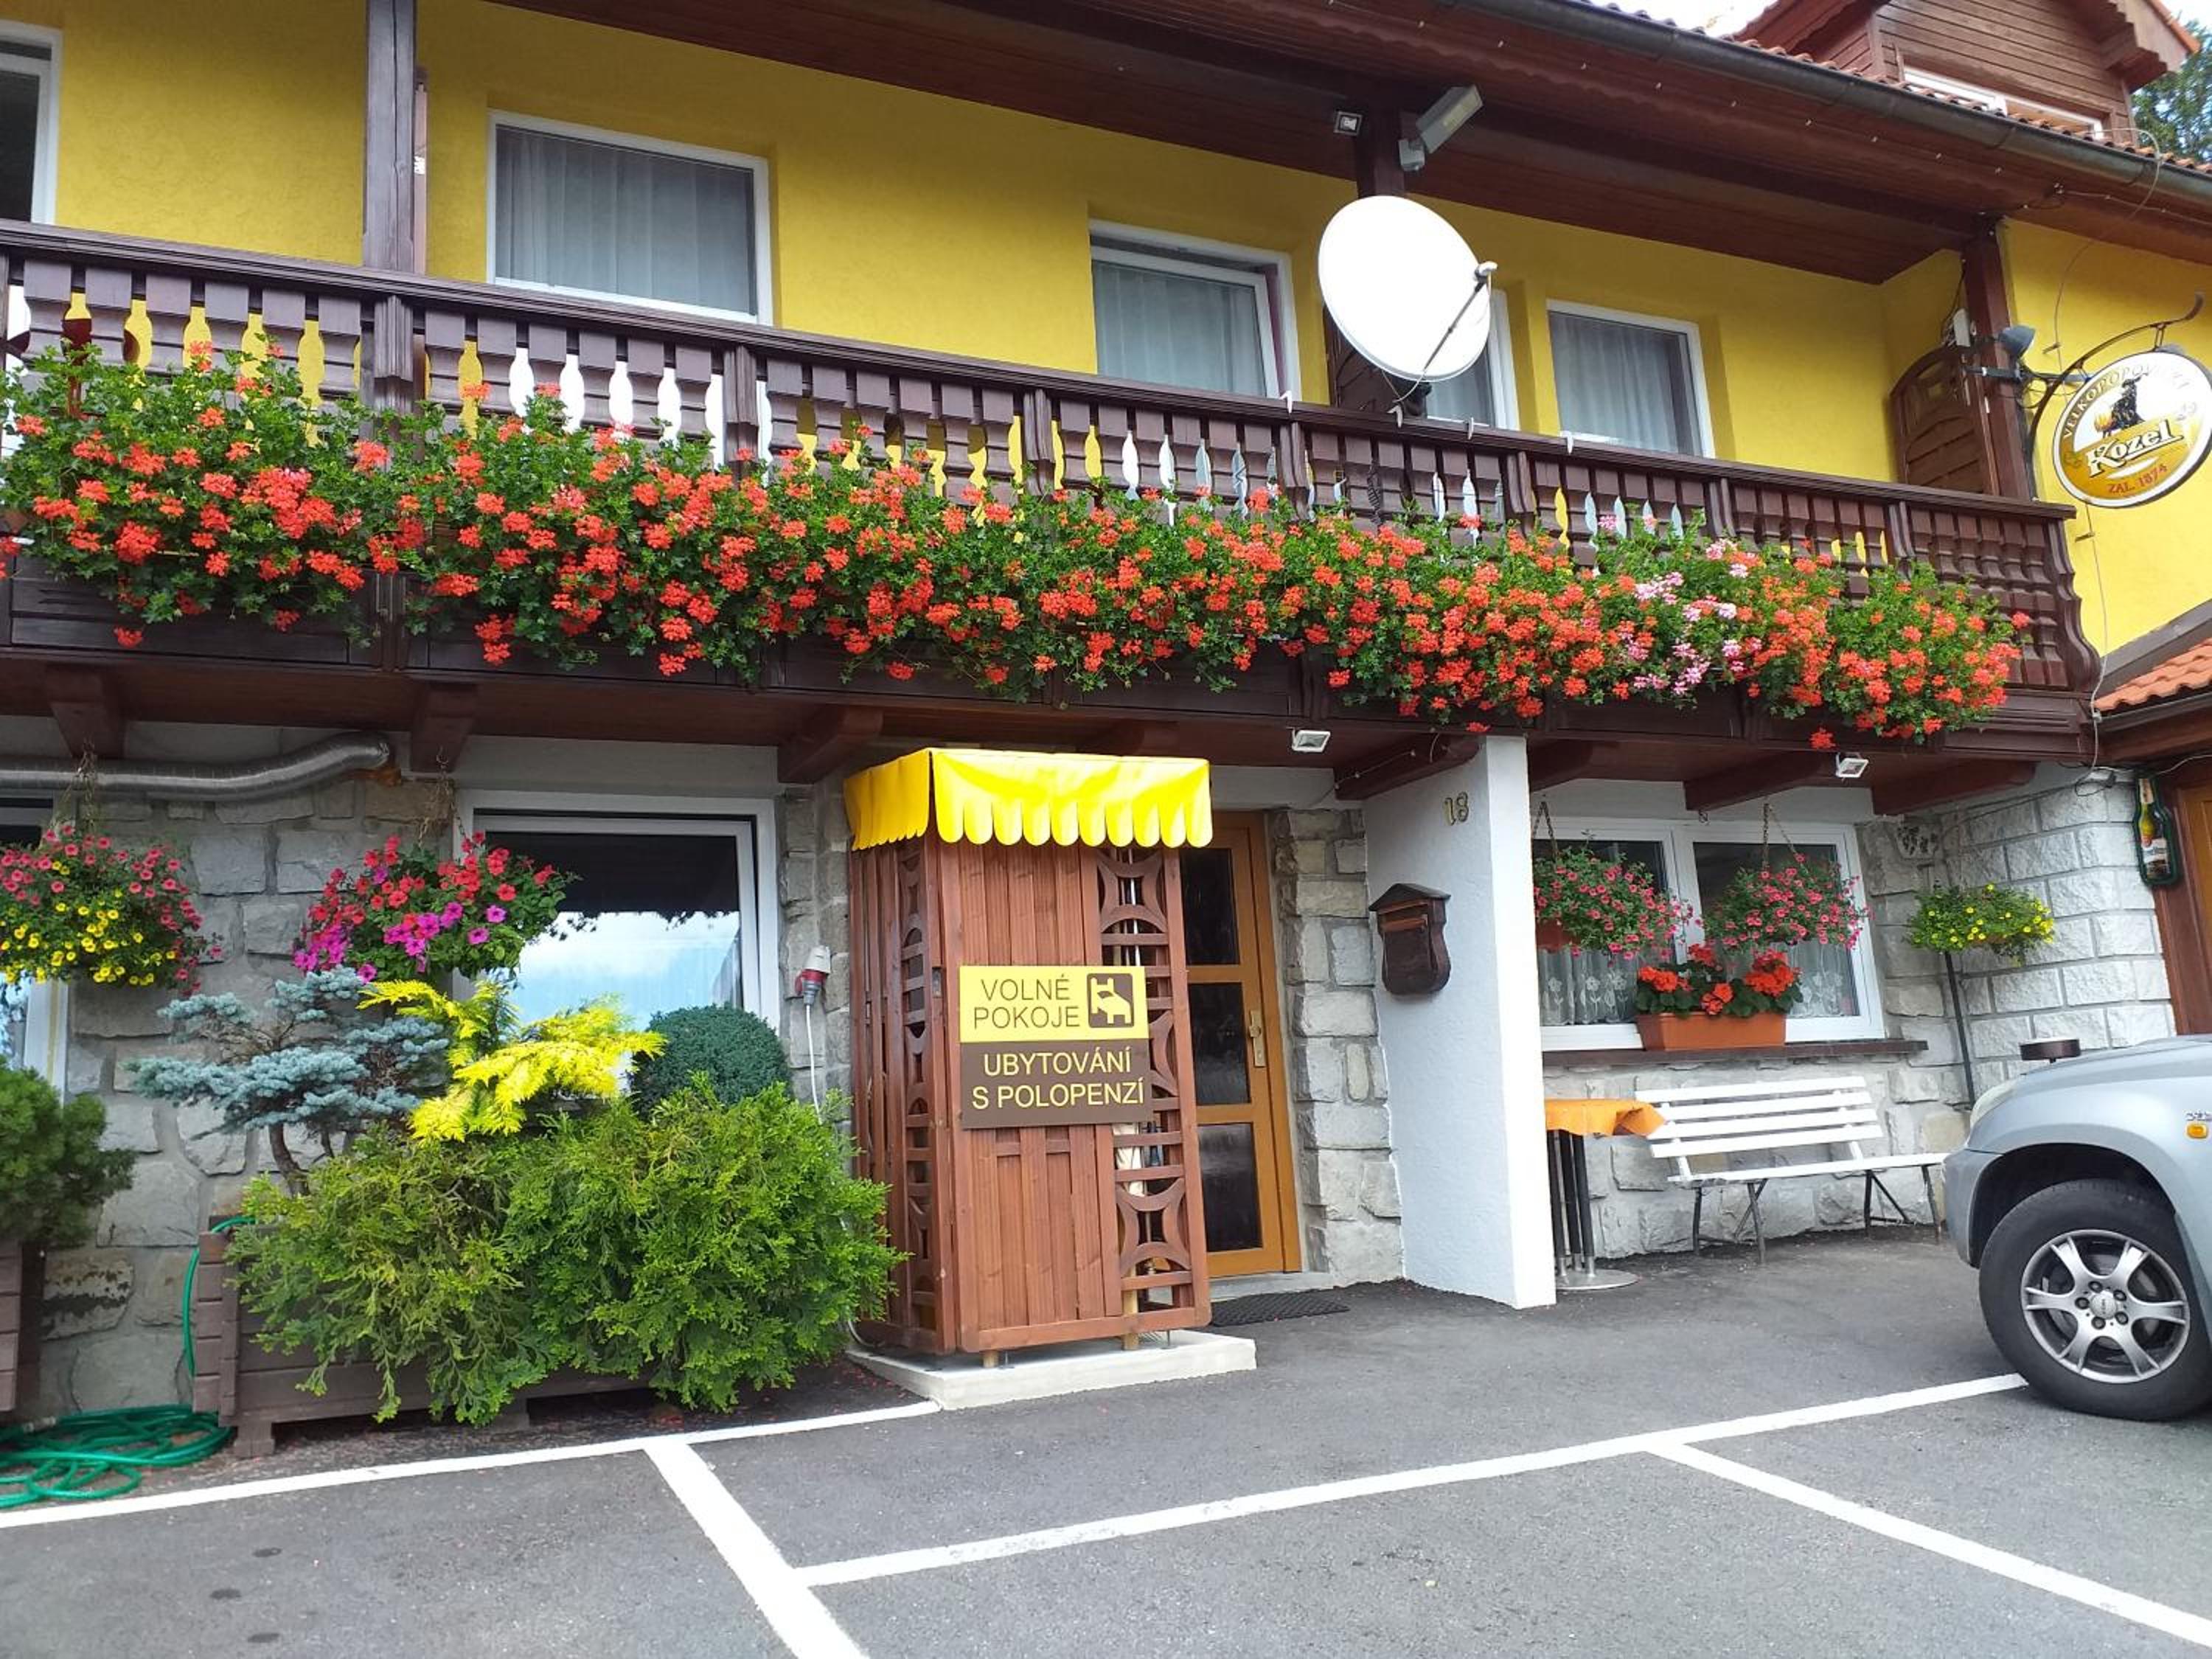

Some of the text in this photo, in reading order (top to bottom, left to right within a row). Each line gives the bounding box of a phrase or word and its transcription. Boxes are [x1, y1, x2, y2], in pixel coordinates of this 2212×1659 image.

[2085, 418, 2177, 478] Kozel
[2138, 462, 2168, 487] 1874
[1443, 790, 1469, 826] 18
[981, 973, 1071, 1001] VOLNÉ
[973, 1005, 1081, 1030] POKOJE
[983, 1046, 1132, 1077] UBYTOVÁNÍ
[972, 1077, 1144, 1110] S POLOPENZÍ
